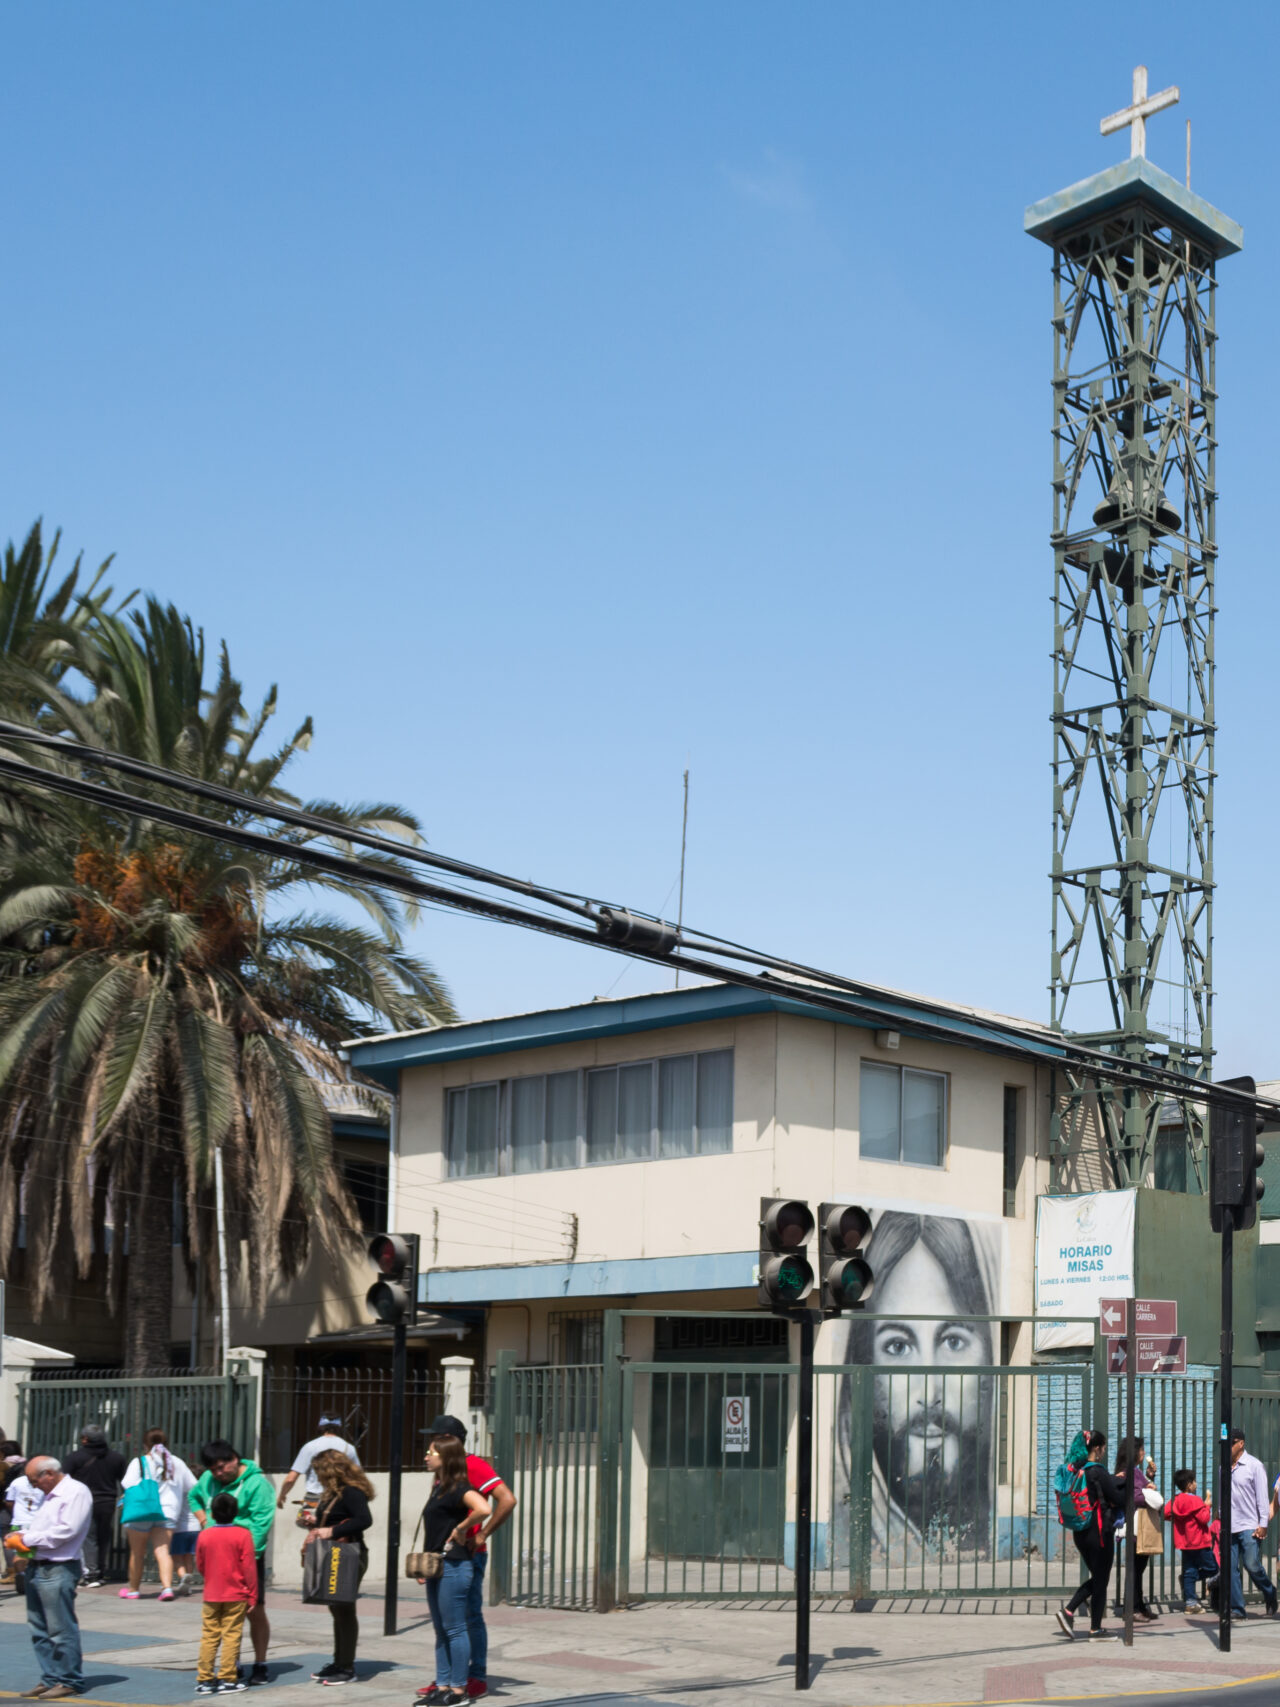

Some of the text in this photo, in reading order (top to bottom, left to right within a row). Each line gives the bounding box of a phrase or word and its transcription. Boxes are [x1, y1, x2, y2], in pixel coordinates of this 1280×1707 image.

[1059, 1244, 1113, 1259] HORARIO
[1067, 1259, 1104, 1273] MISAS
[1040, 1278, 1059, 1286] LUNES
[1066, 1276, 1091, 1284] VIERNES
[1135, 1304, 1151, 1312] CALLE
[1135, 1313, 1157, 1321] CARRERA
[1139, 1342, 1154, 1350] CALLE
[1139, 1351, 1162, 1360] ALDUNATE
